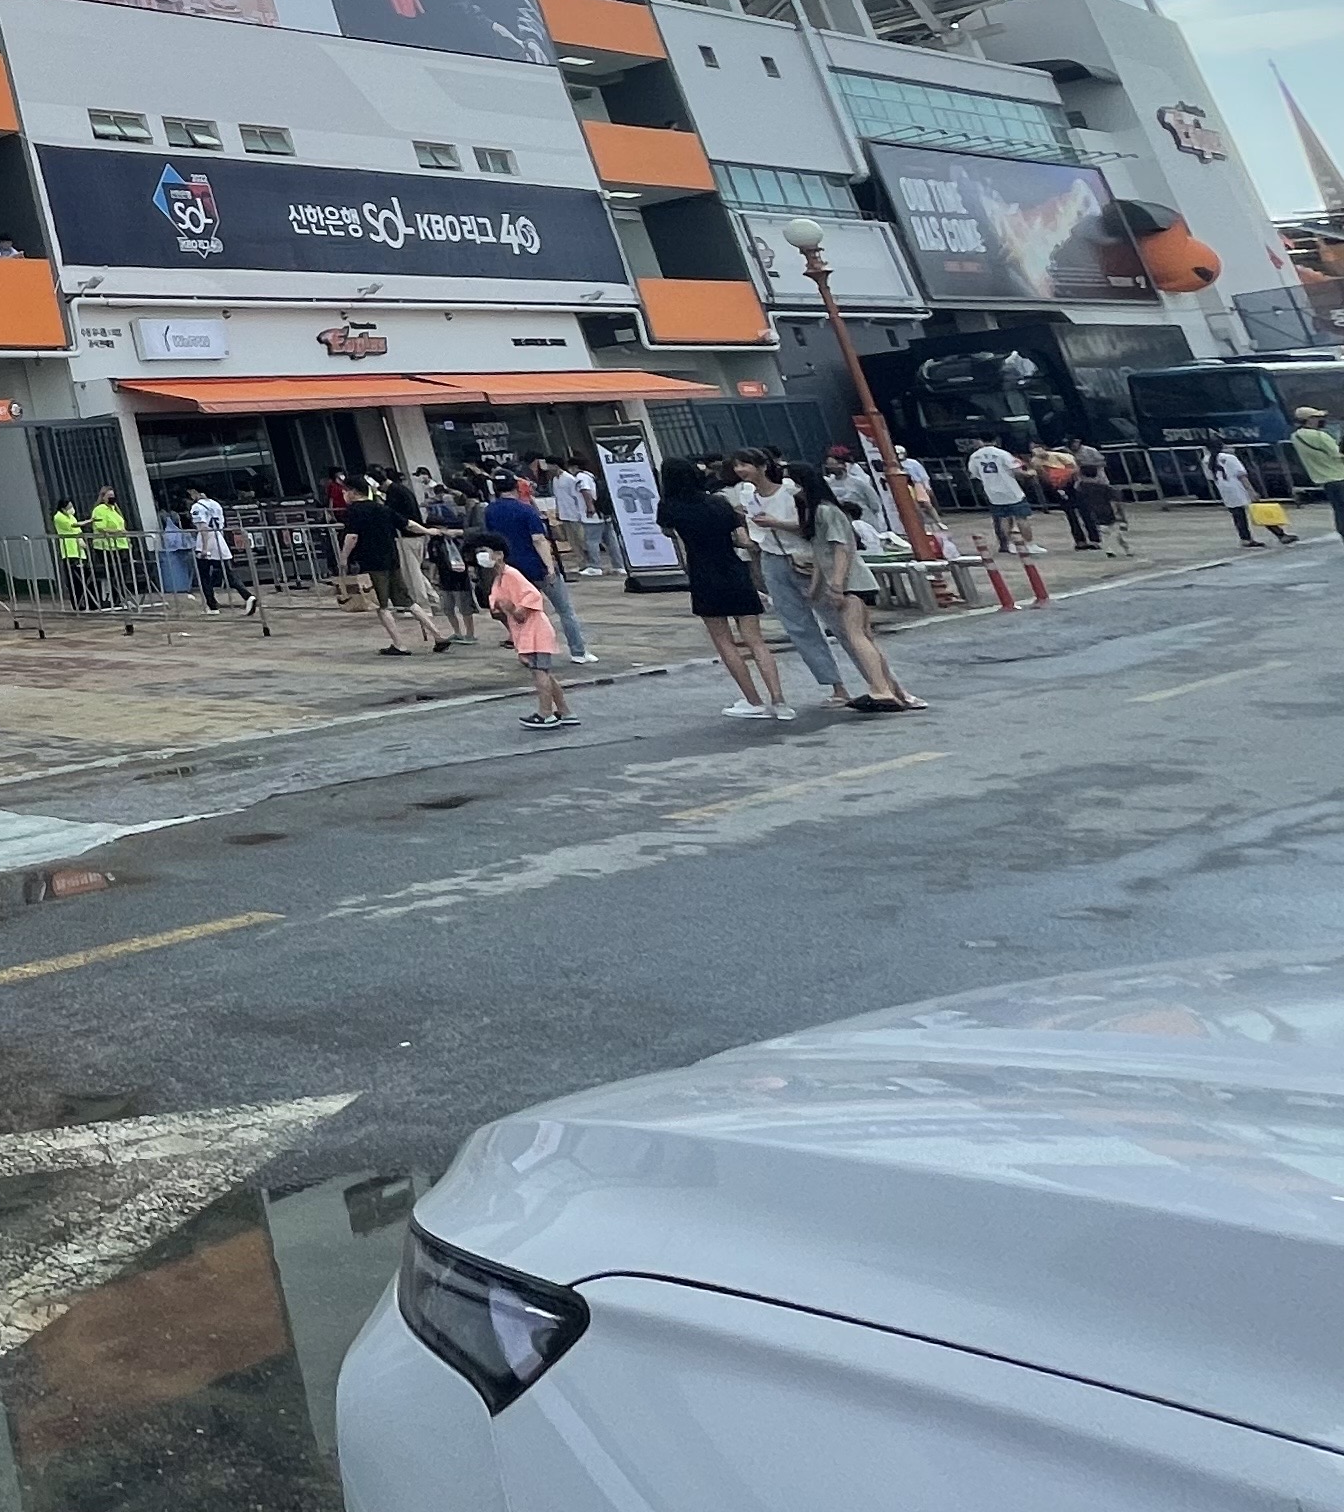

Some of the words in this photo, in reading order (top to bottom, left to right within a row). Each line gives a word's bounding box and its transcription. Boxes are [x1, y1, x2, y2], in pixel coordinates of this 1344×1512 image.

[174, 198, 213, 234] SOL
[288, 204, 362, 238] 신한은행
[362, 197, 415, 249] SOL
[415, 213, 497, 243] KBO리그
